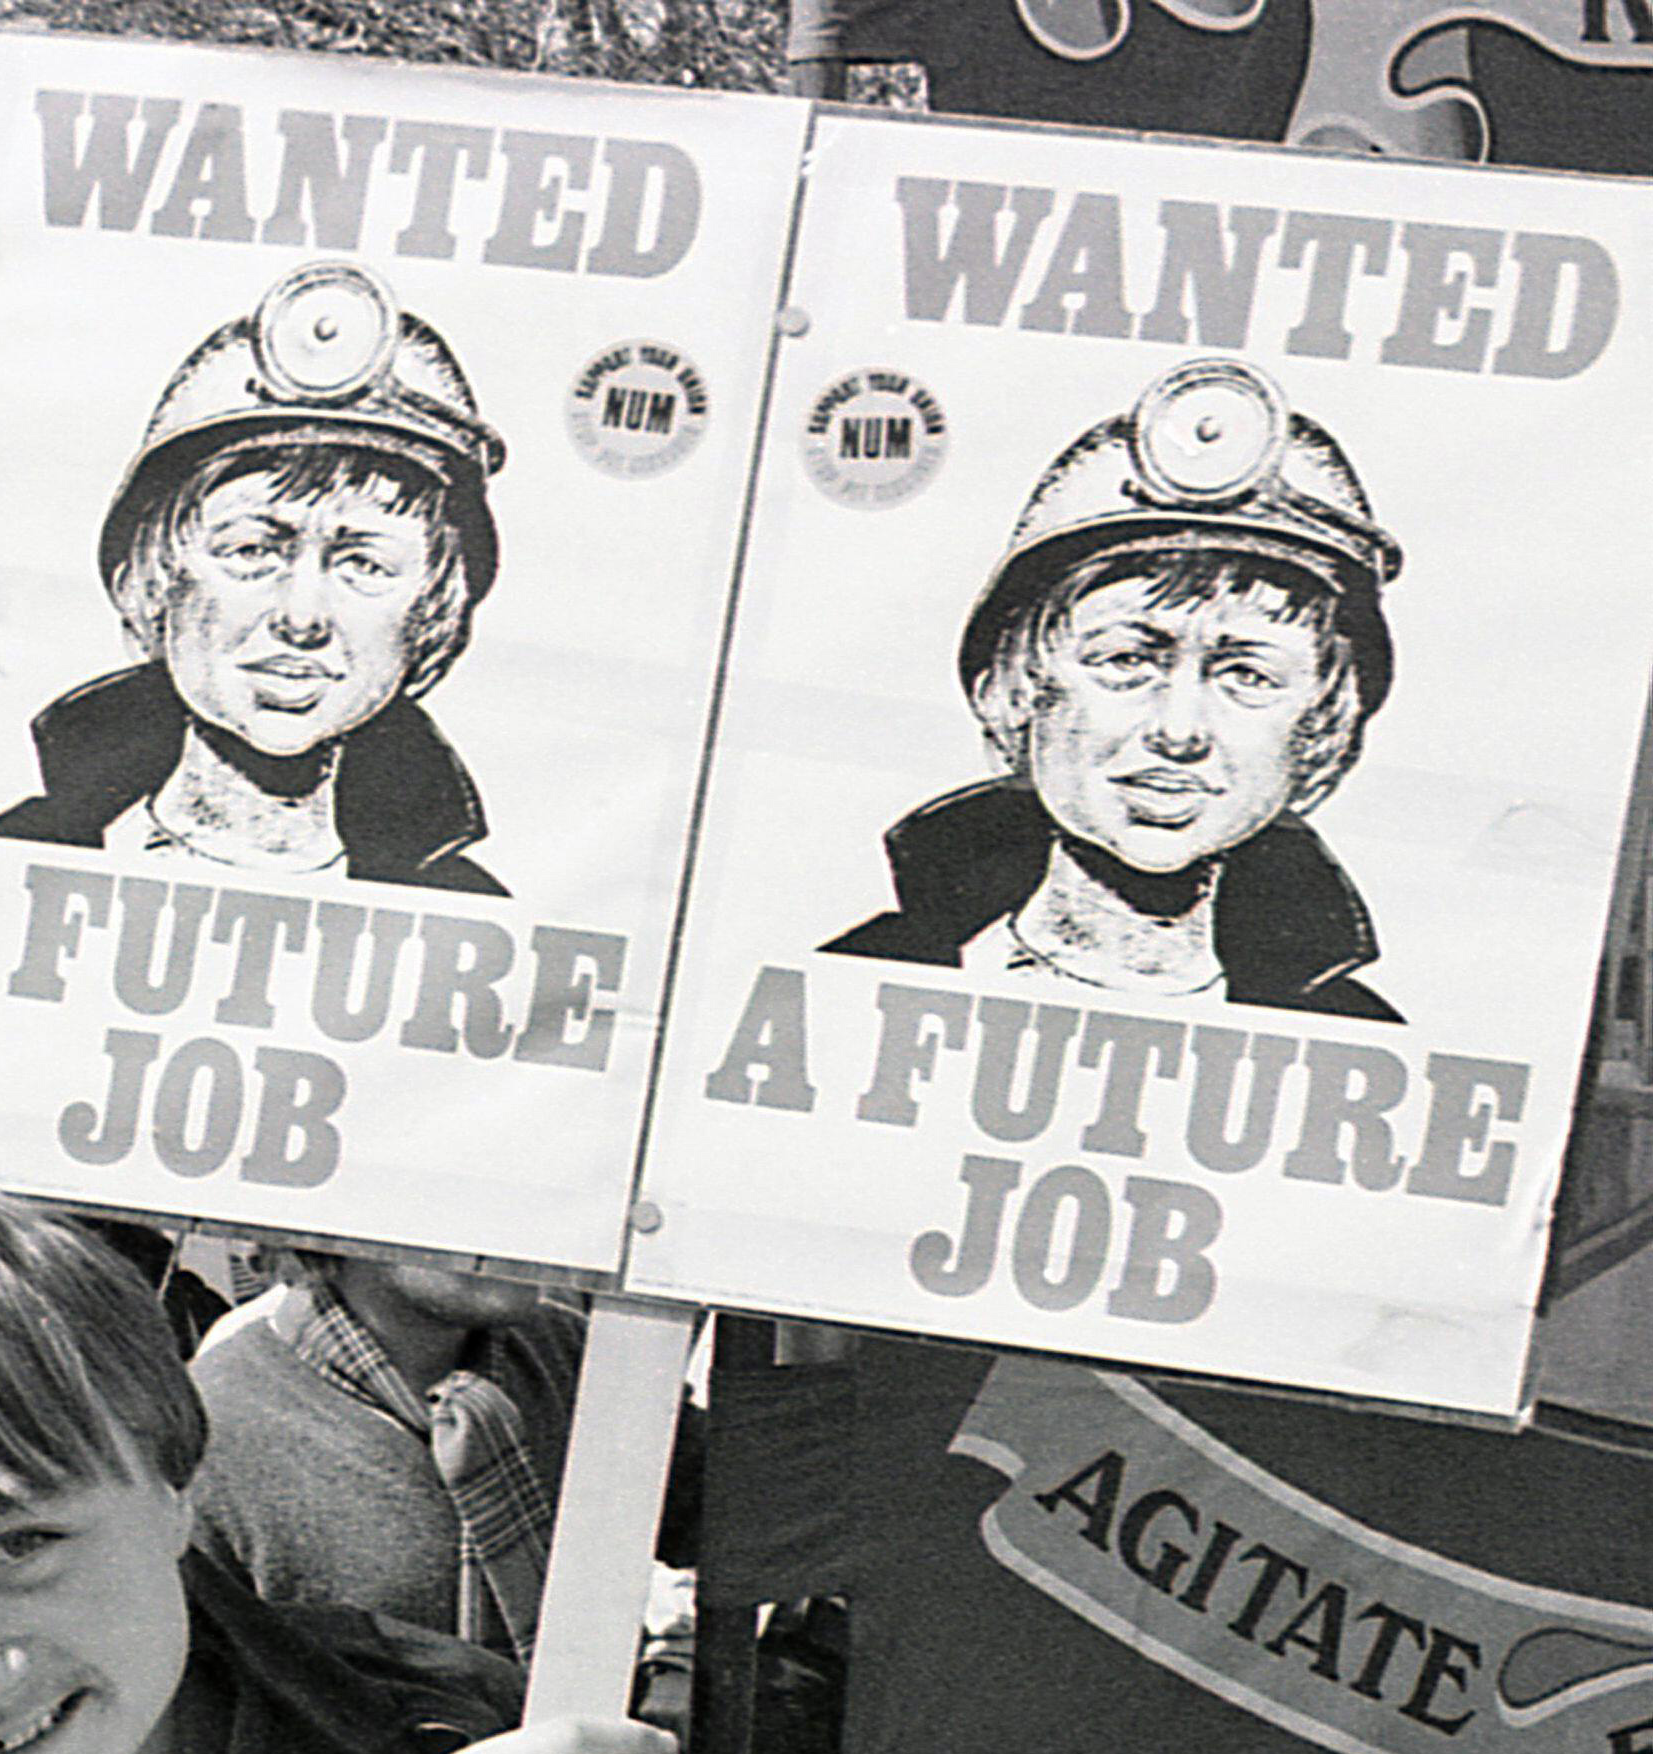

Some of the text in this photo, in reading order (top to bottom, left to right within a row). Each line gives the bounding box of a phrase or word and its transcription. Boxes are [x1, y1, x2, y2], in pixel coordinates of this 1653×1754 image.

[34, 87, 704, 280] WANTED
[896, 175, 1622, 381] WANTED
[602, 387, 677, 434] NUM
[839, 417, 912, 459] NUM
[7, 863, 631, 1074] FUTURE
[58, 1027, 348, 1189] JOB
[704, 965, 1532, 1208] A FUTURE
[909, 1153, 1224, 1327] JOB
[1033, 1450, 1484, 1738] AGITATE
